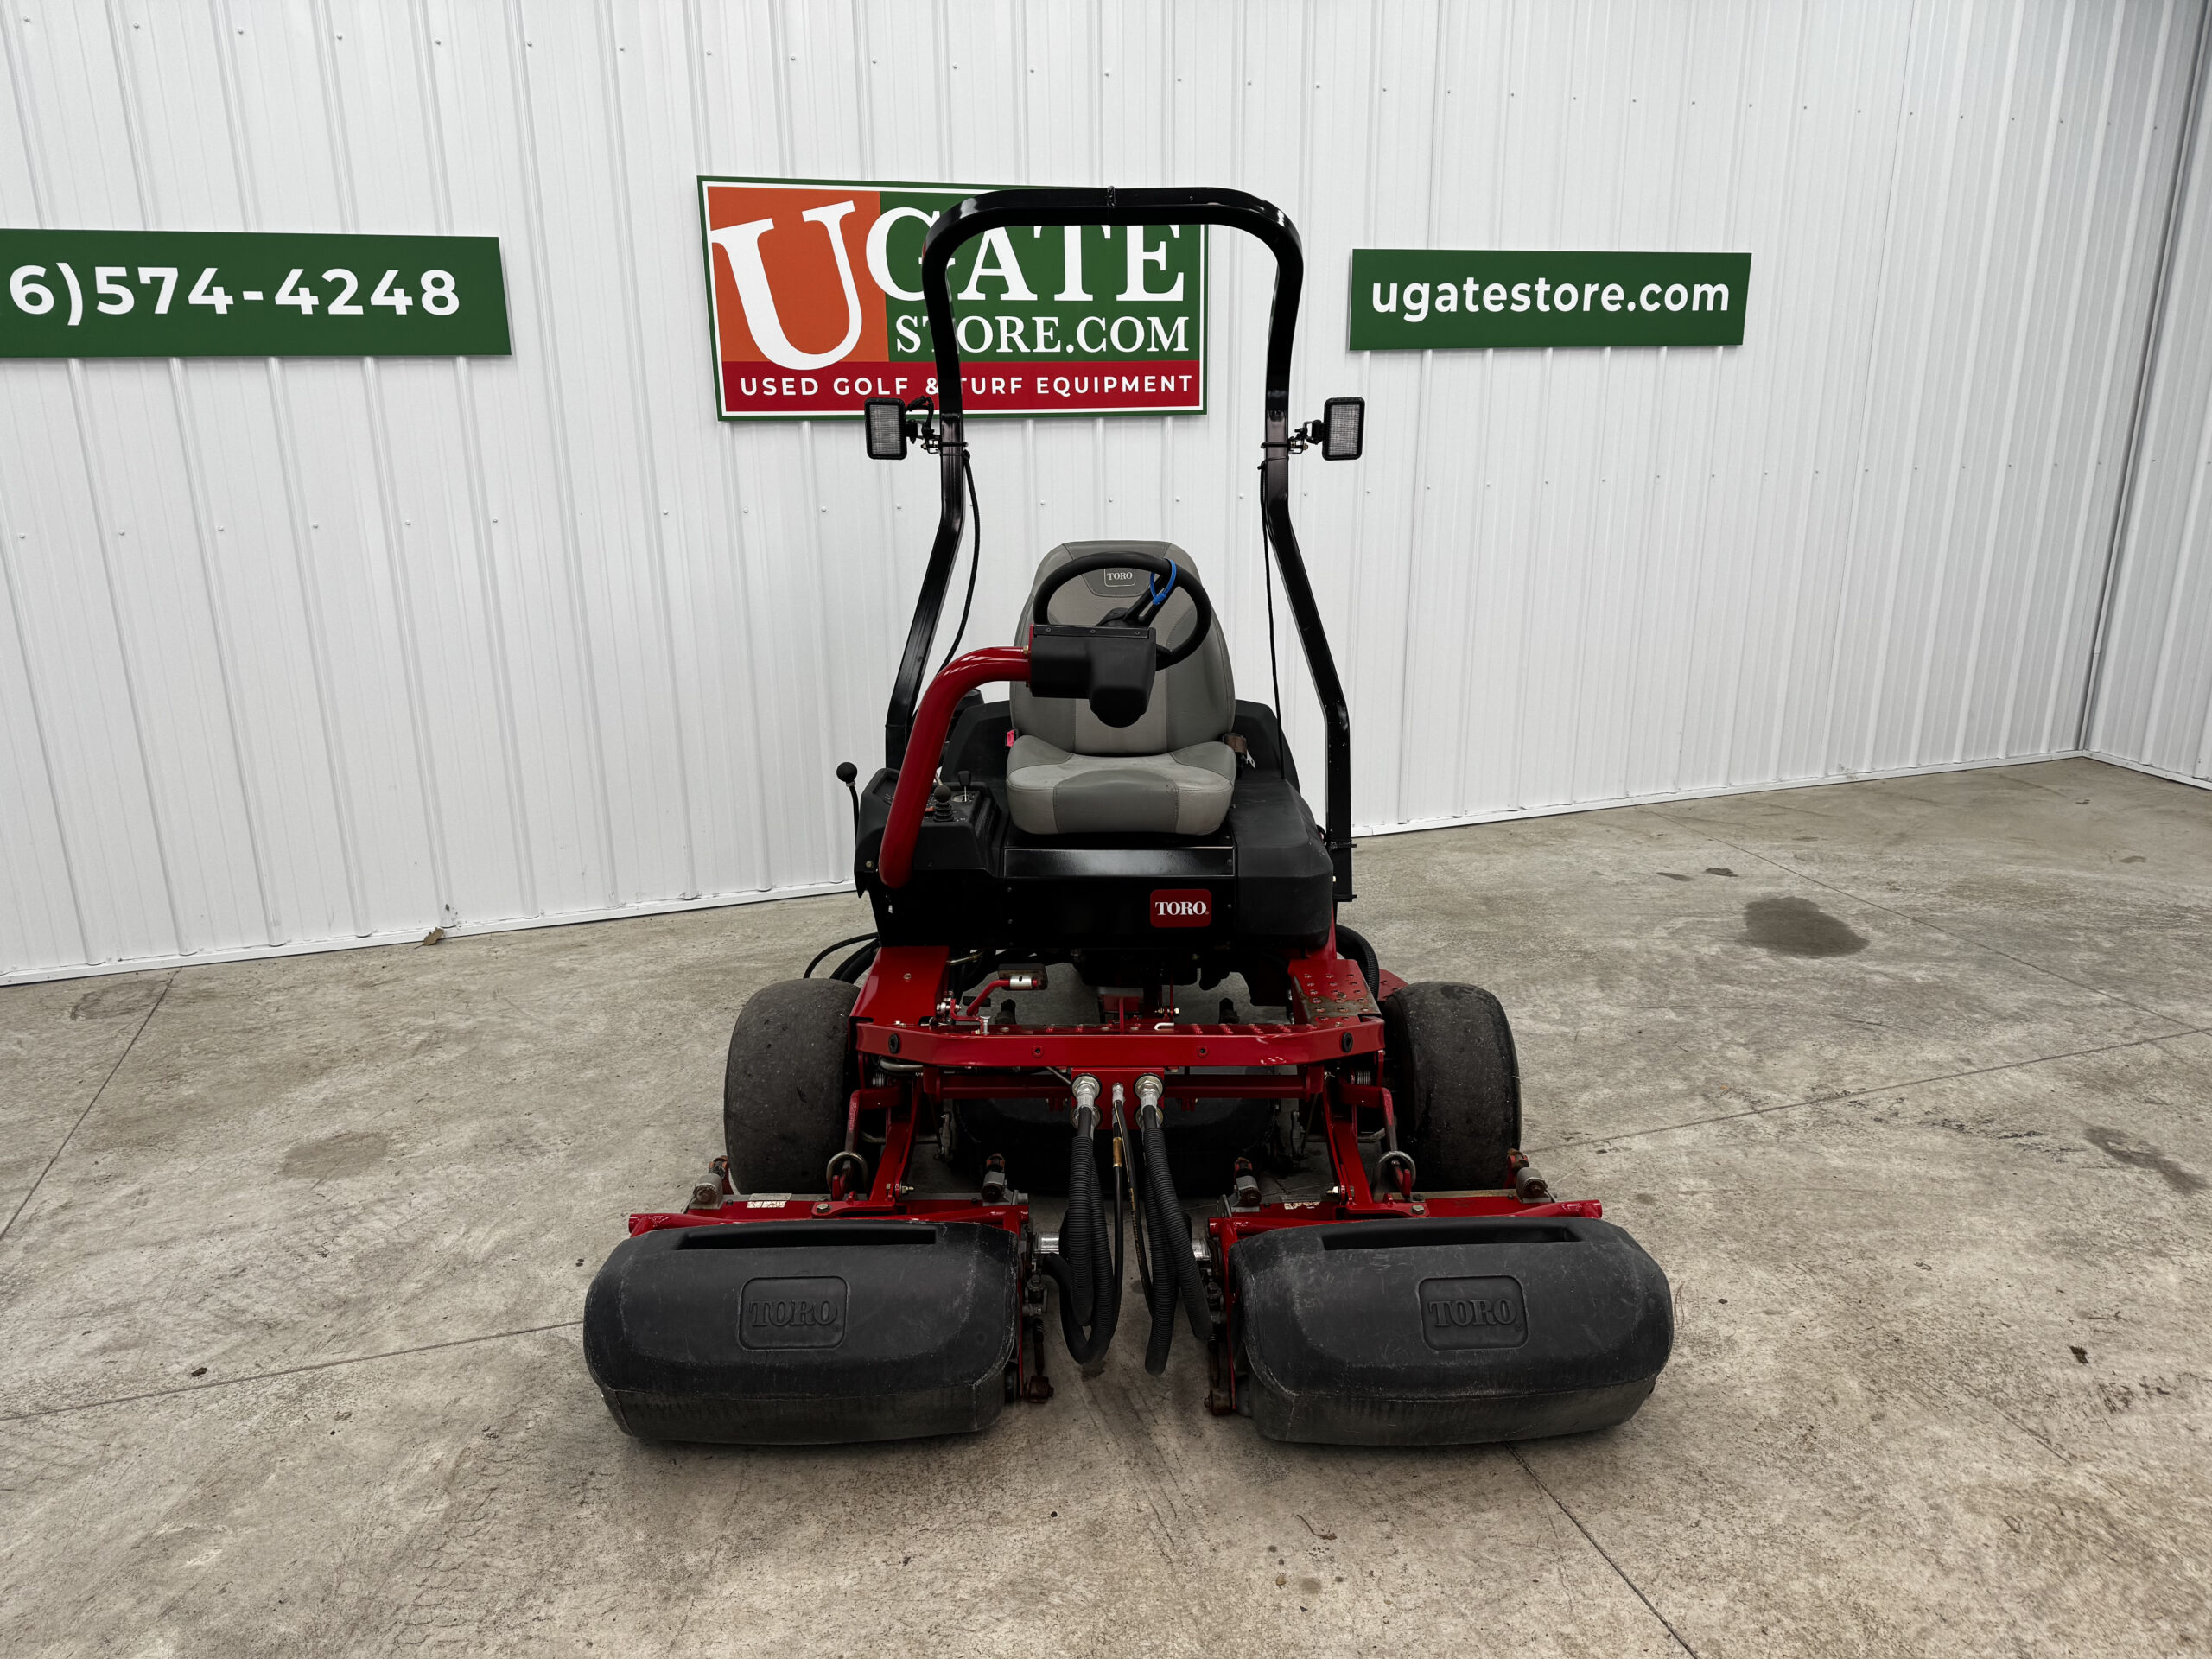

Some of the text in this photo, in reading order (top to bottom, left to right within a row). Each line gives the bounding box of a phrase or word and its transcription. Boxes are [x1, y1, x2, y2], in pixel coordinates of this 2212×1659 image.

[9, 262, 460, 326] 6)574-4248
[1372, 276, 1729, 323] ugatestore.com
[895, 315, 1189, 353] SORE.COM
[741, 378, 818, 396] USED
[833, 377, 908, 396] GOLF
[1037, 375, 1192, 397] EQUIPMENT
[1107, 571, 1133, 581] TORO
[1154, 900, 1207, 916] TORO
[748, 1300, 838, 1327] TORO
[1427, 1298, 1517, 1327] TORO
